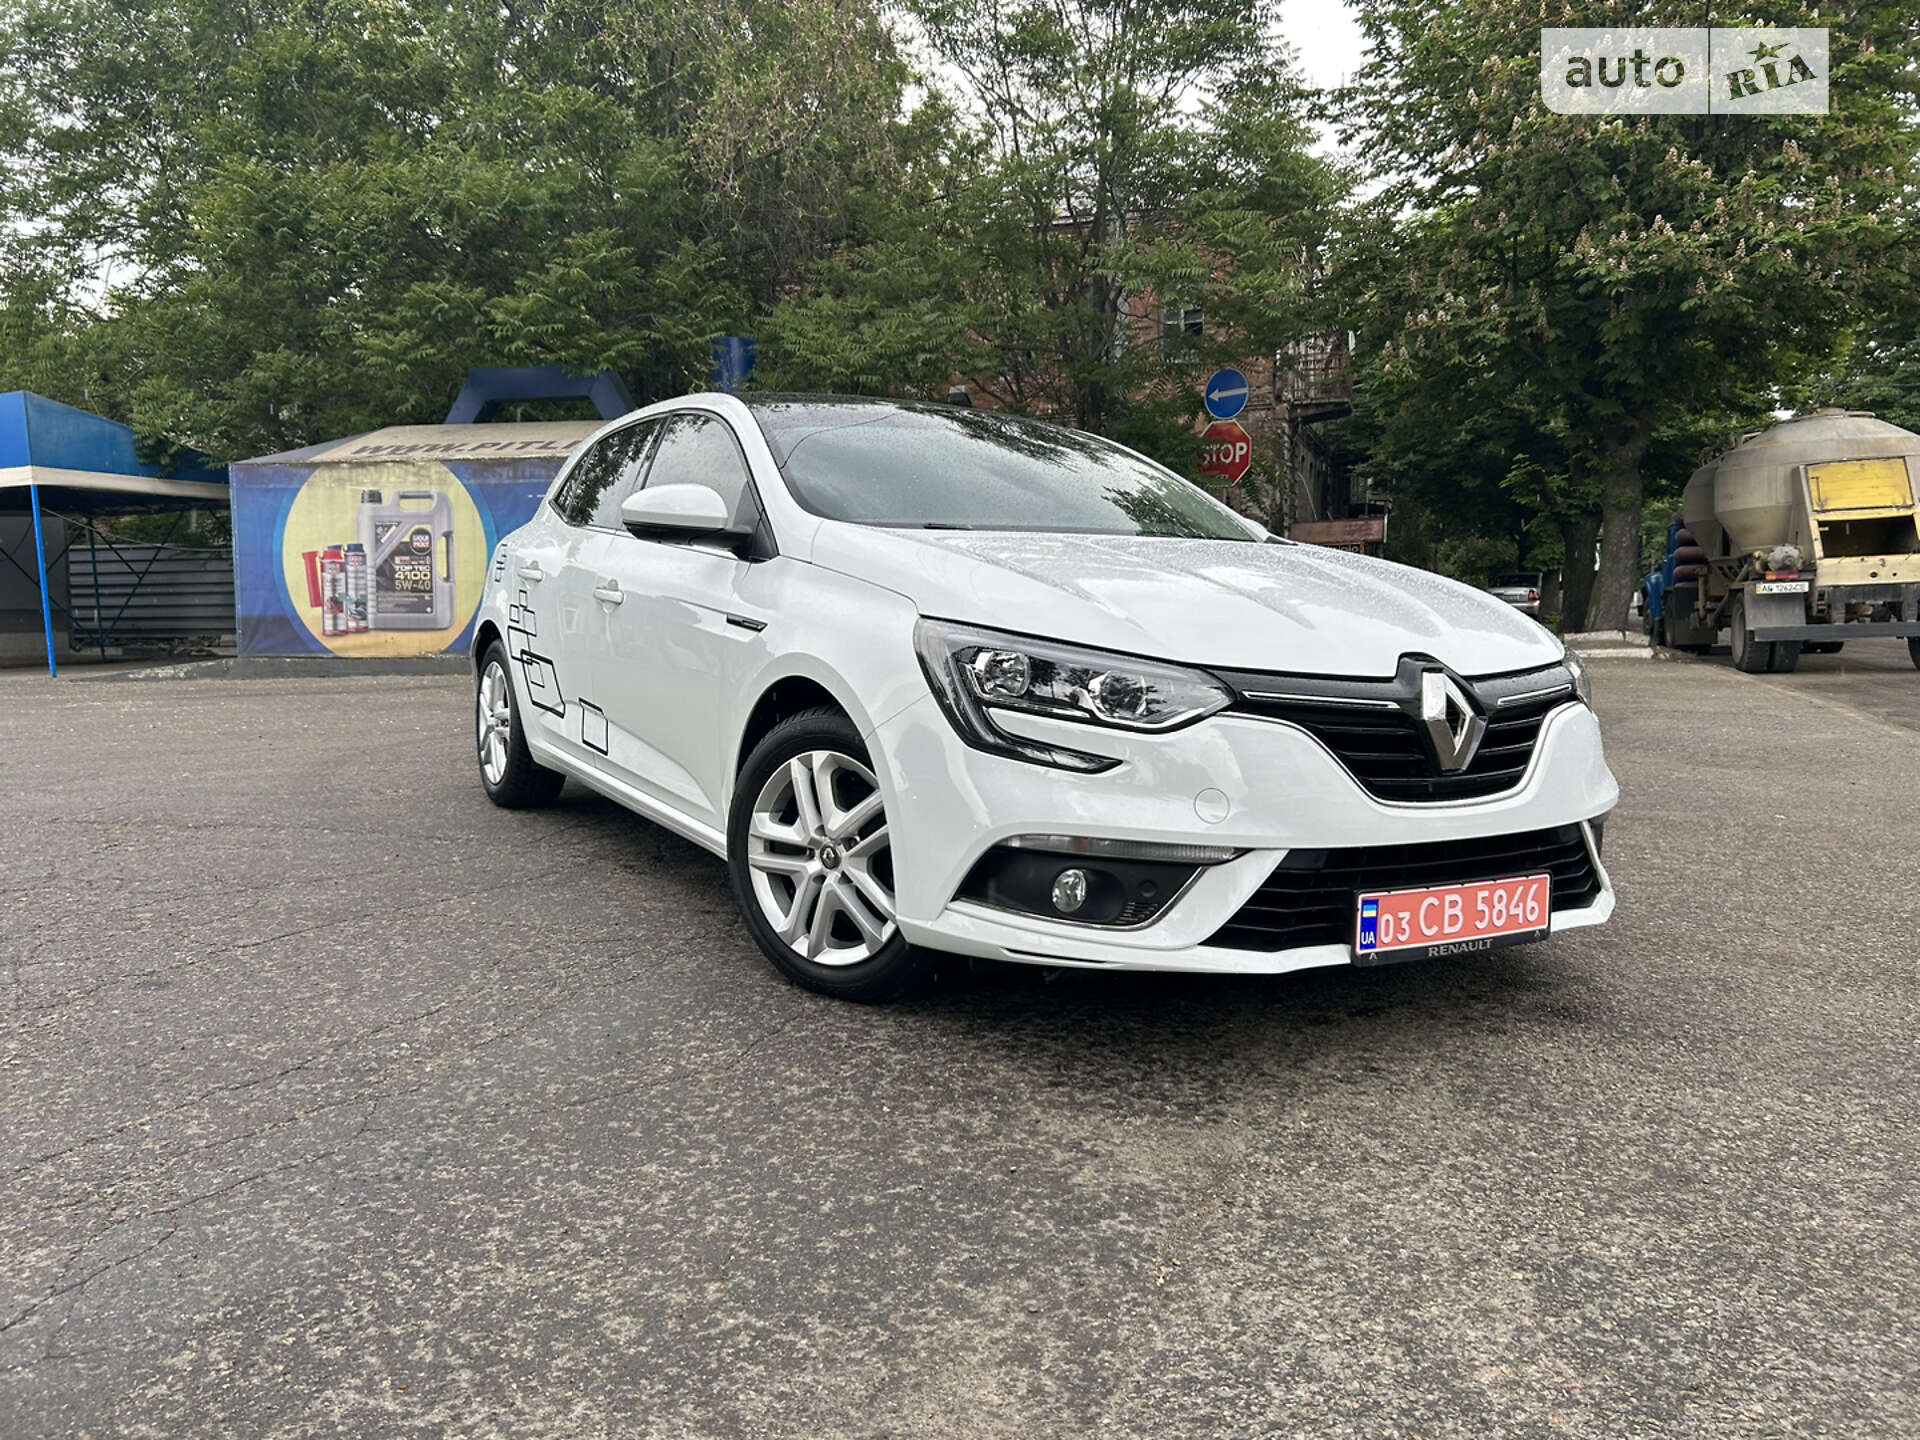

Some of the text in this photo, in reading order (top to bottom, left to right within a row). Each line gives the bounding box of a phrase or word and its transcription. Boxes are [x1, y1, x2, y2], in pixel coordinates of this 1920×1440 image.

[394, 571, 431, 580] 4100
[395, 580, 431, 590] 5W-40
[1380, 883, 1540, 944] 03 CB 5846
[1360, 931, 1376, 944] UA
[1428, 939, 1493, 957] RENAULT
